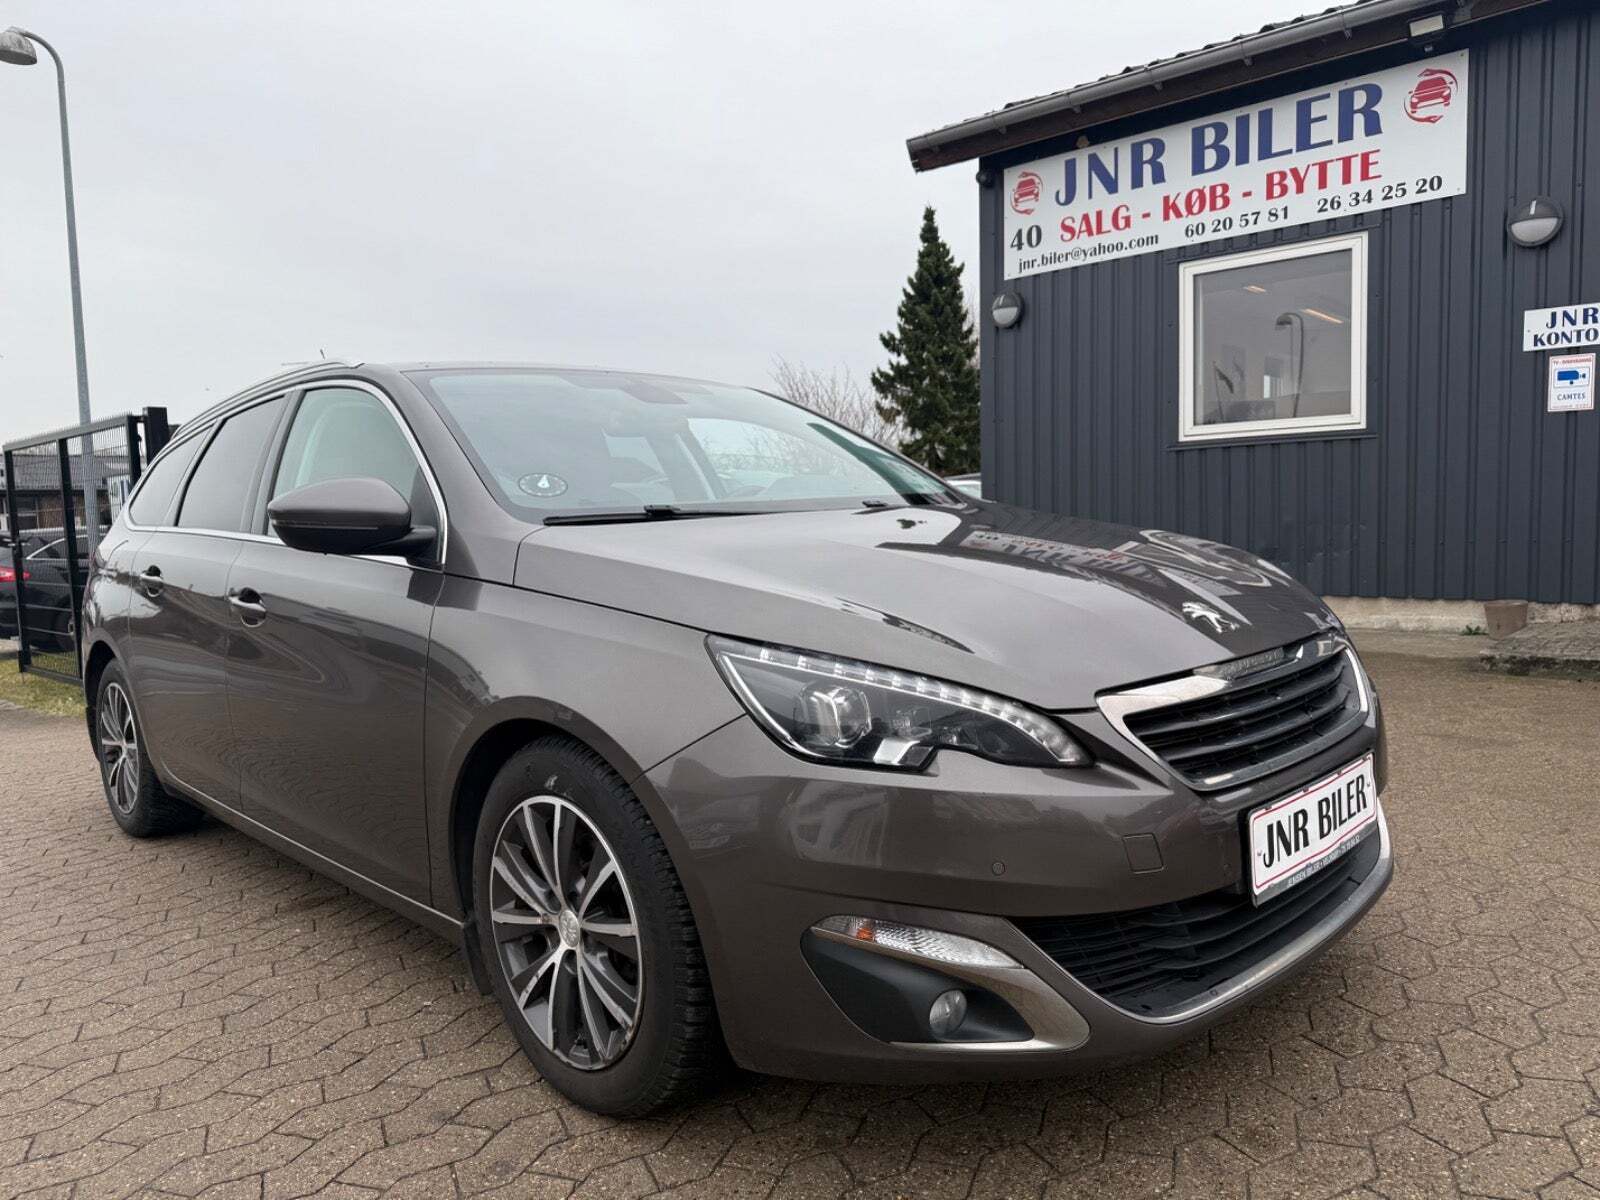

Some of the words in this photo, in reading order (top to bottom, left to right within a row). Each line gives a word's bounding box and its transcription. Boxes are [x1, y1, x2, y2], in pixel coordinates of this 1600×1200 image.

[1055, 137, 1166, 206] JNR
[1191, 83, 1383, 176] BILER
[1060, 204, 1131, 242] SALG
[1162, 182, 1231, 222] KØB
[1242, 190, 1253, 199] -
[1265, 148, 1382, 201] BYTTE
[1317, 195, 1341, 213] 26
[1348, 189, 1373, 207] 34
[1381, 182, 1407, 200] 25
[1415, 175, 1443, 194] 20
[1010, 224, 1042, 251] 40
[1184, 221, 1205, 238] 60
[1211, 216, 1233, 233] 20
[1239, 211, 1261, 228] 57
[1267, 206, 1289, 223] 81
[1018, 234, 1159, 273] jnr.biler@yahoo.com
[1546, 307, 1599, 329] JNR
[1263, 808, 1310, 868] JNR
[1318, 774, 1367, 839] BILER
